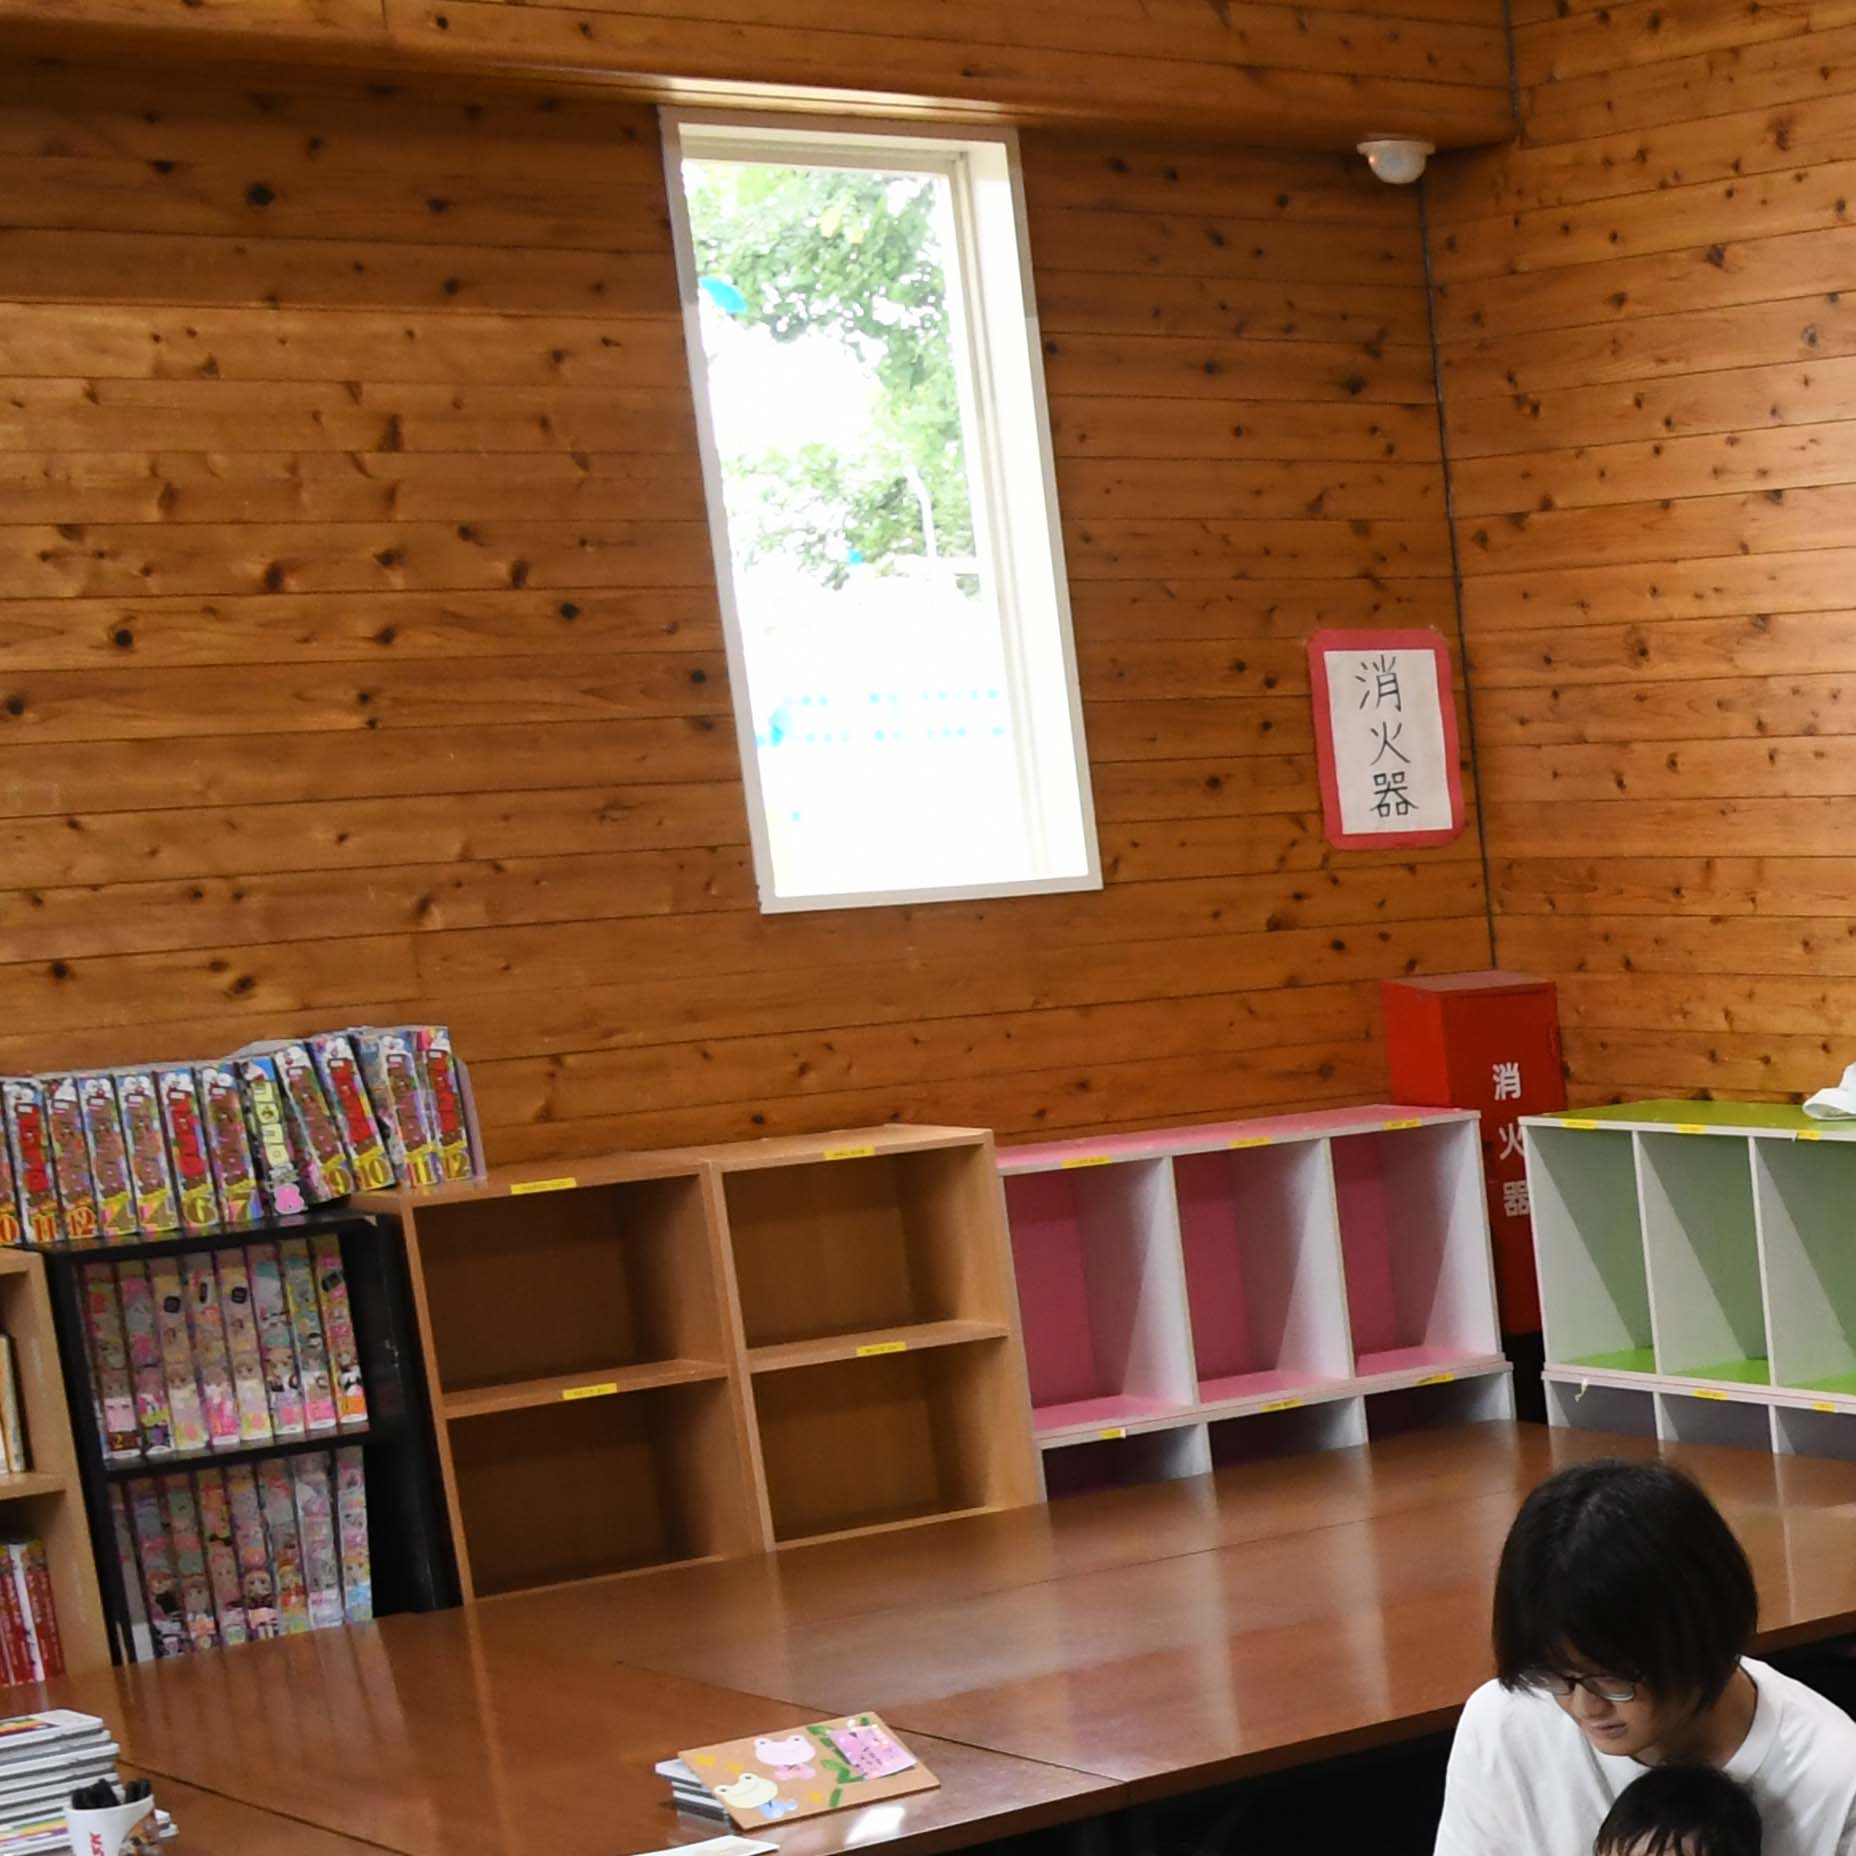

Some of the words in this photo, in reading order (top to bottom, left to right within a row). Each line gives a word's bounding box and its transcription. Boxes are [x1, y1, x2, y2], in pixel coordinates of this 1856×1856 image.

[1355, 654, 1419, 818] 消火器
[1492, 1062, 1531, 1217] 消火器
[360, 1157, 391, 1190] 10
[446, 1151, 471, 1180] 12
[69, 1206, 96, 1239] 12
[183, 1194, 218, 1226] 6
[226, 1191, 252, 1223] 7
